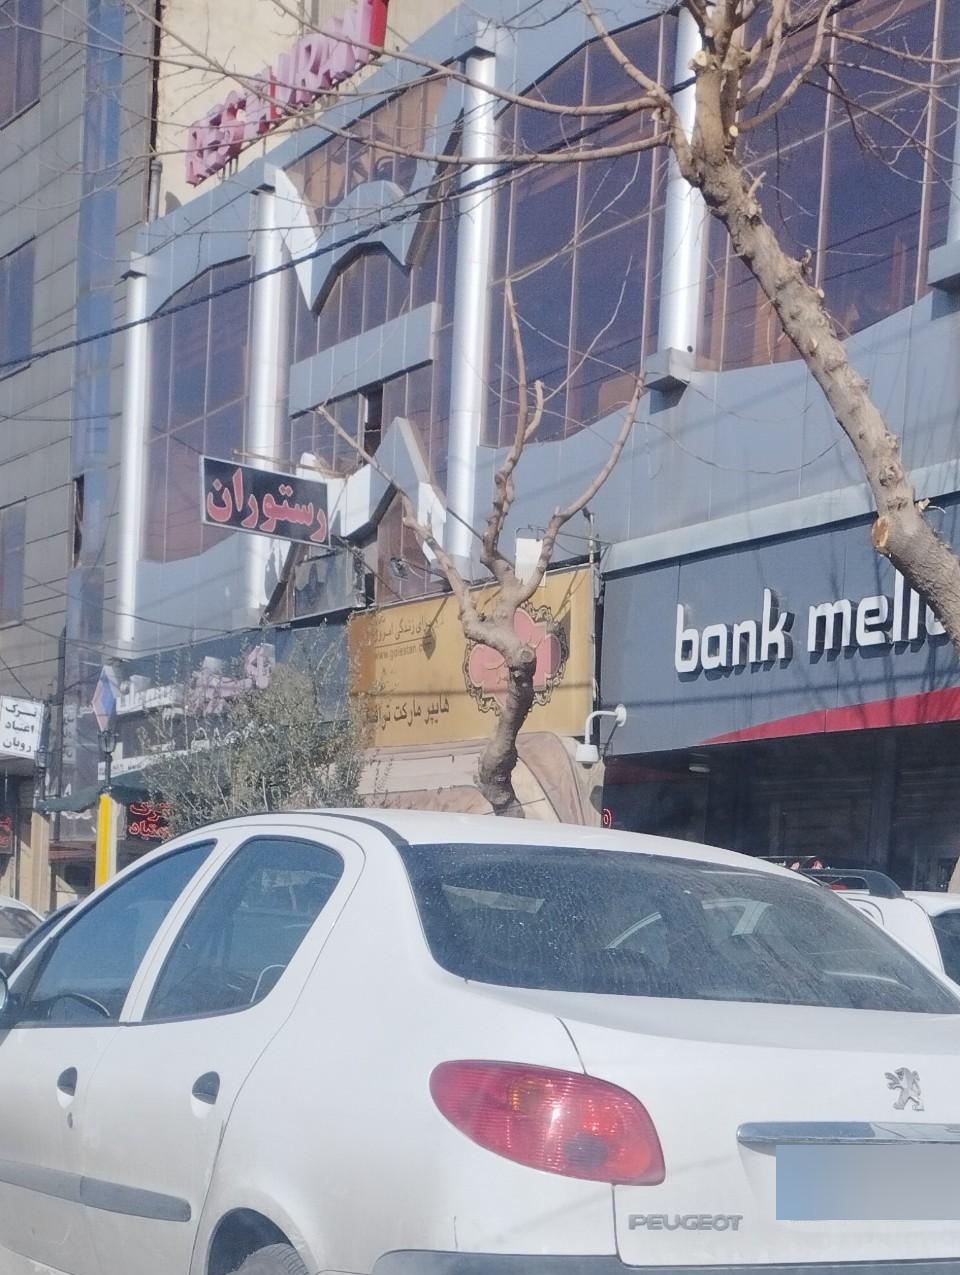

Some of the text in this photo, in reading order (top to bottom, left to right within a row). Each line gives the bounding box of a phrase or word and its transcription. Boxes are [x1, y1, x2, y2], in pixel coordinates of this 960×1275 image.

[207, 467, 327, 543] رستوران
[675, 588, 790, 674] bank
[5, 704, 37, 718] ترک
[628, 1213, 744, 1231] PEUGEOT
